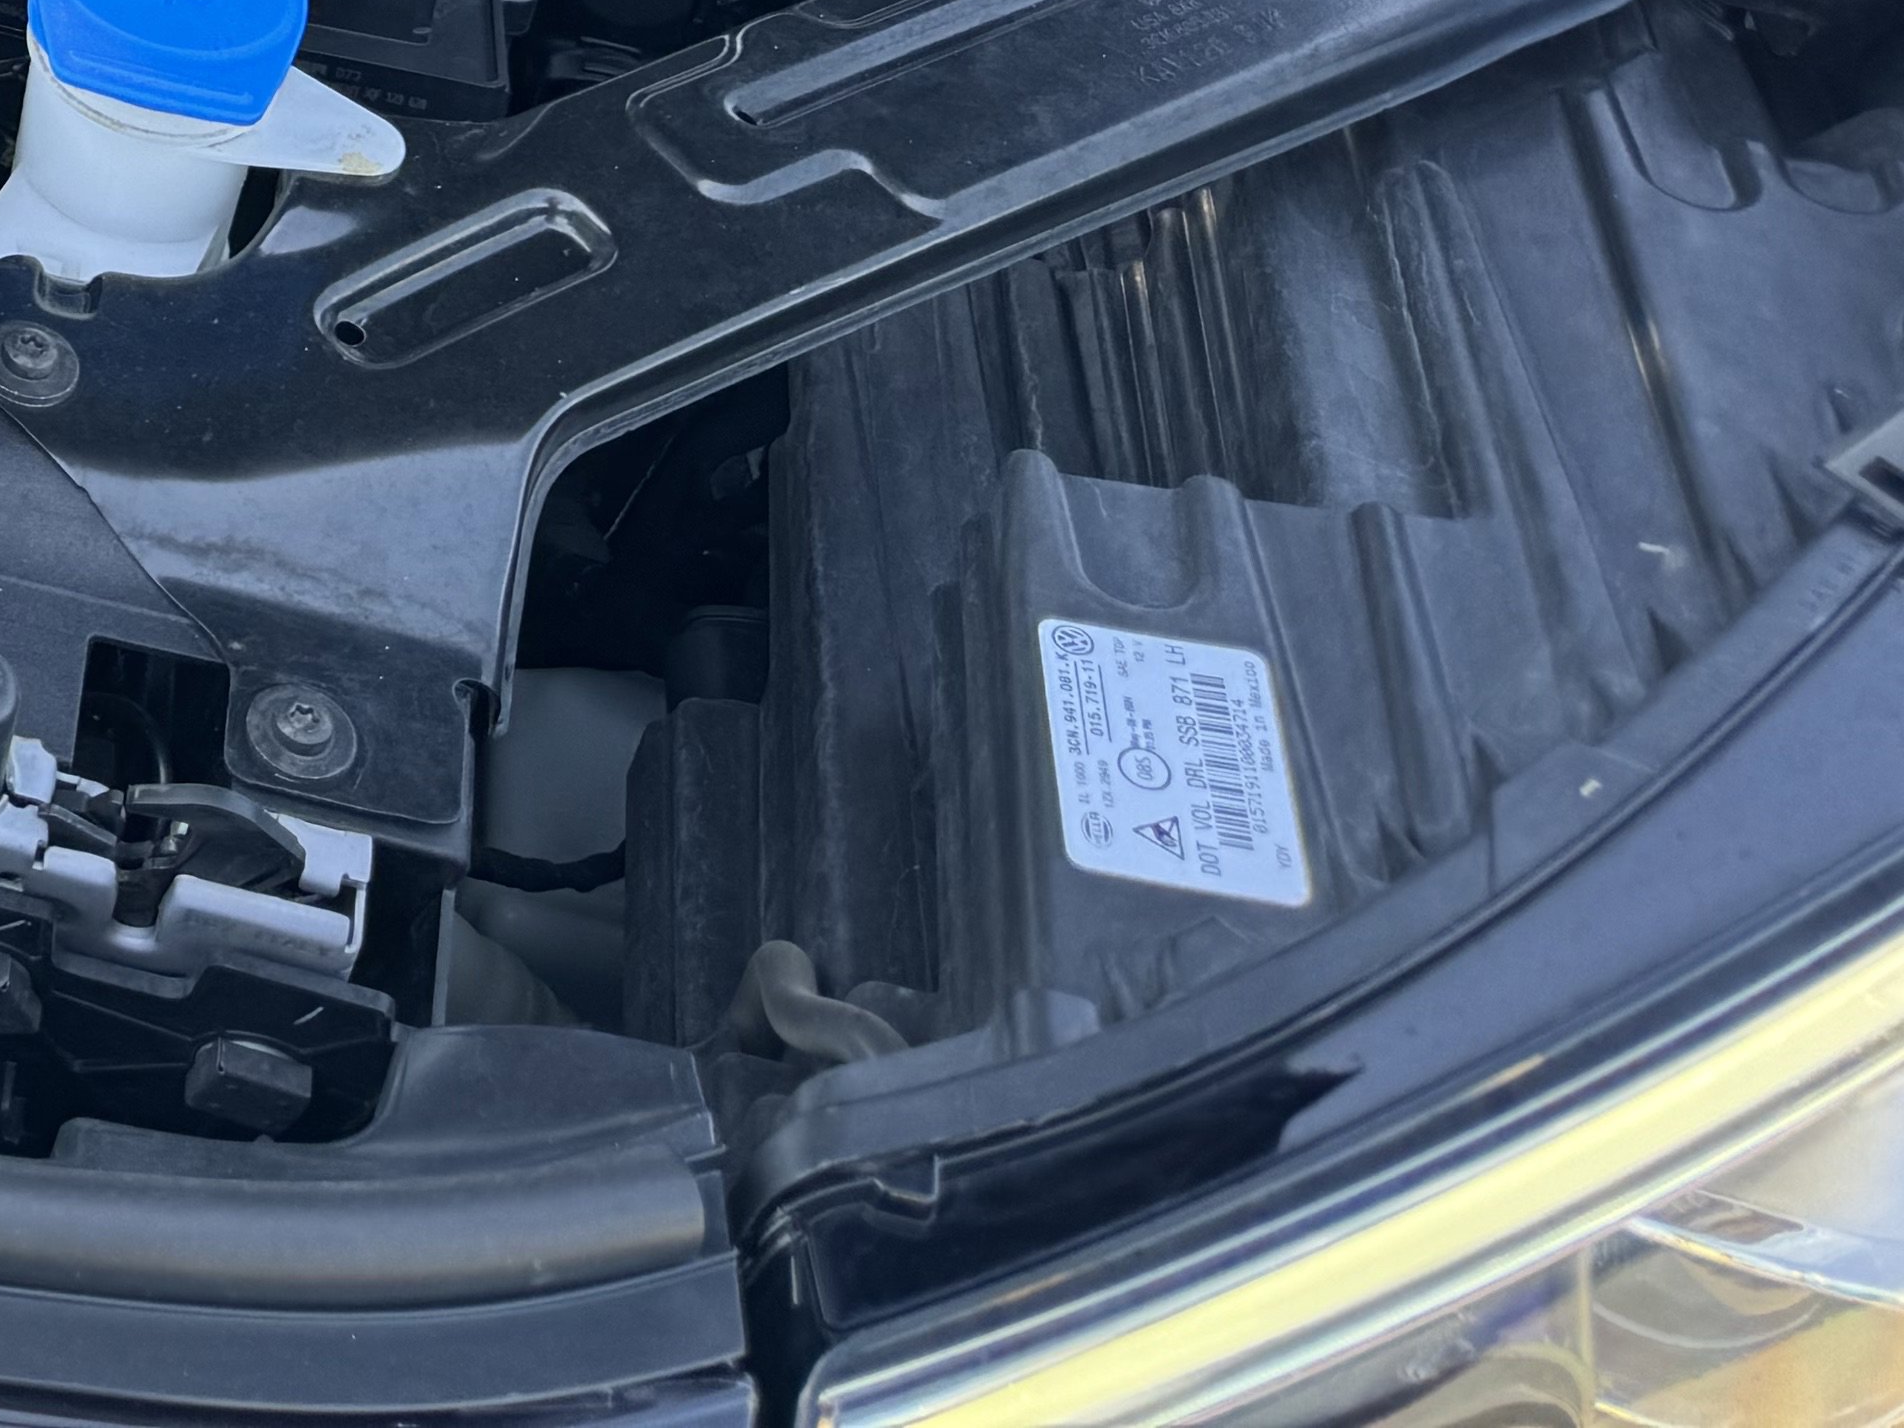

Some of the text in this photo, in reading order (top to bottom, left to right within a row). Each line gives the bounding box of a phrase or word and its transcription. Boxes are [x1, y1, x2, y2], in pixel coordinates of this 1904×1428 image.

[1055, 651, 1082, 756] 3CN.941.081.K
[1080, 659, 1105, 737] 015.719-11
[1243, 660, 1274, 772] Made in Mexico
[1164, 643, 1222, 877] DOT VOL DRL SSB 871 LH
